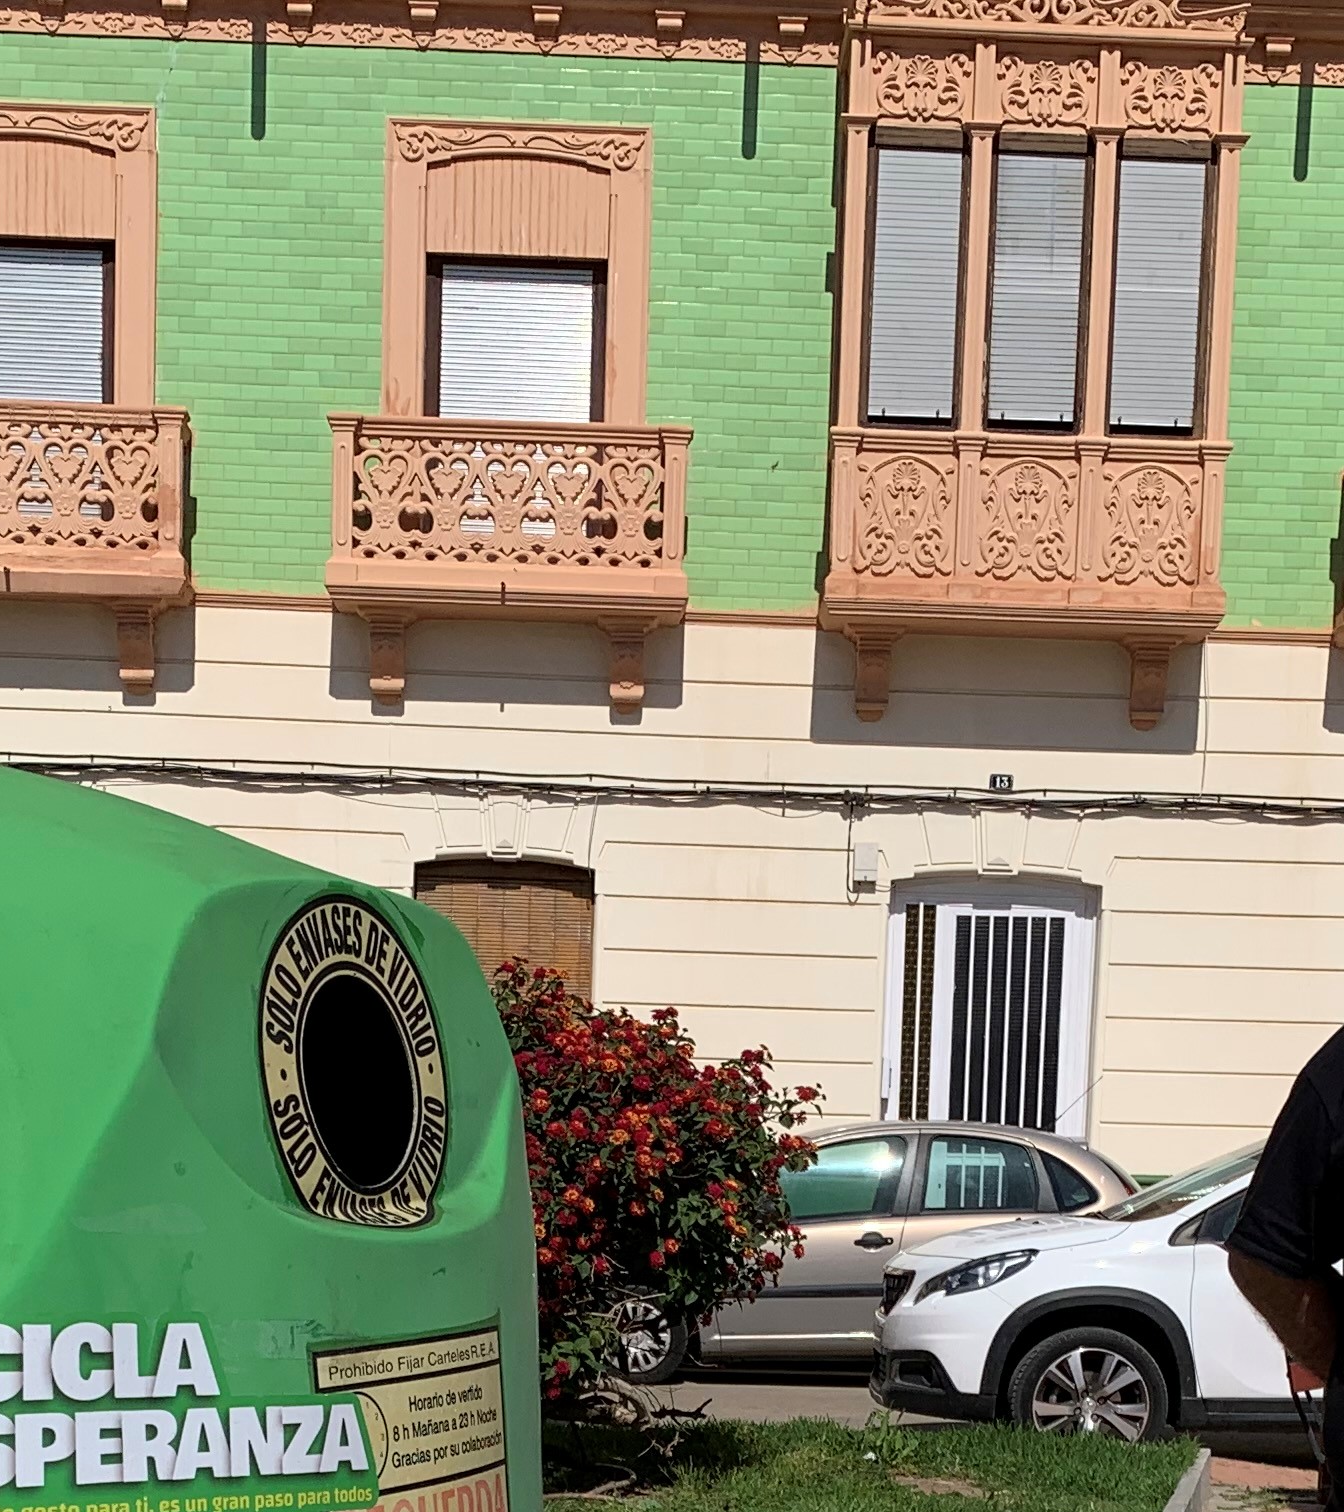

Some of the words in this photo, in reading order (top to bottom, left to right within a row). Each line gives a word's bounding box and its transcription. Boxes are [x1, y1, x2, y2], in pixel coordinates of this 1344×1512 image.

[995, 775, 1009, 788] 13
[285, 904, 363, 983] ENVASES
[363, 920, 391, 978] DE
[386, 945, 438, 1058] VIDRIO
[406, 1095, 446, 1204] VIDRIO
[328, 1358, 394, 1381] Prohibido
[397, 1355, 425, 1373] Fijar
[427, 1348, 470, 1367] Carteles
[408, 1393, 444, 1413] Horario
[445, 1390, 456, 1405] de
[458, 1383, 483, 1403] vertido
[392, 1425, 400, 1442] 8
[402, 1424, 410, 1440] h
[412, 1418, 450, 1439] Mañana
[451, 1417, 458, 1430] a
[458, 1411, 469, 1429] 23
[469, 1411, 476, 1426] h
[476, 1407, 498, 1425] Noche
[391, 1448, 431, 1469] Gracias
[433, 1444, 449, 1465] por
[450, 1439, 460, 1453] su
[461, 1428, 503, 1451] colaboración
[186, 1496, 208, 1512] un
[254, 1491, 294, 1512] paso
[297, 1489, 331, 1510] para
[334, 1484, 373, 1504] todos
